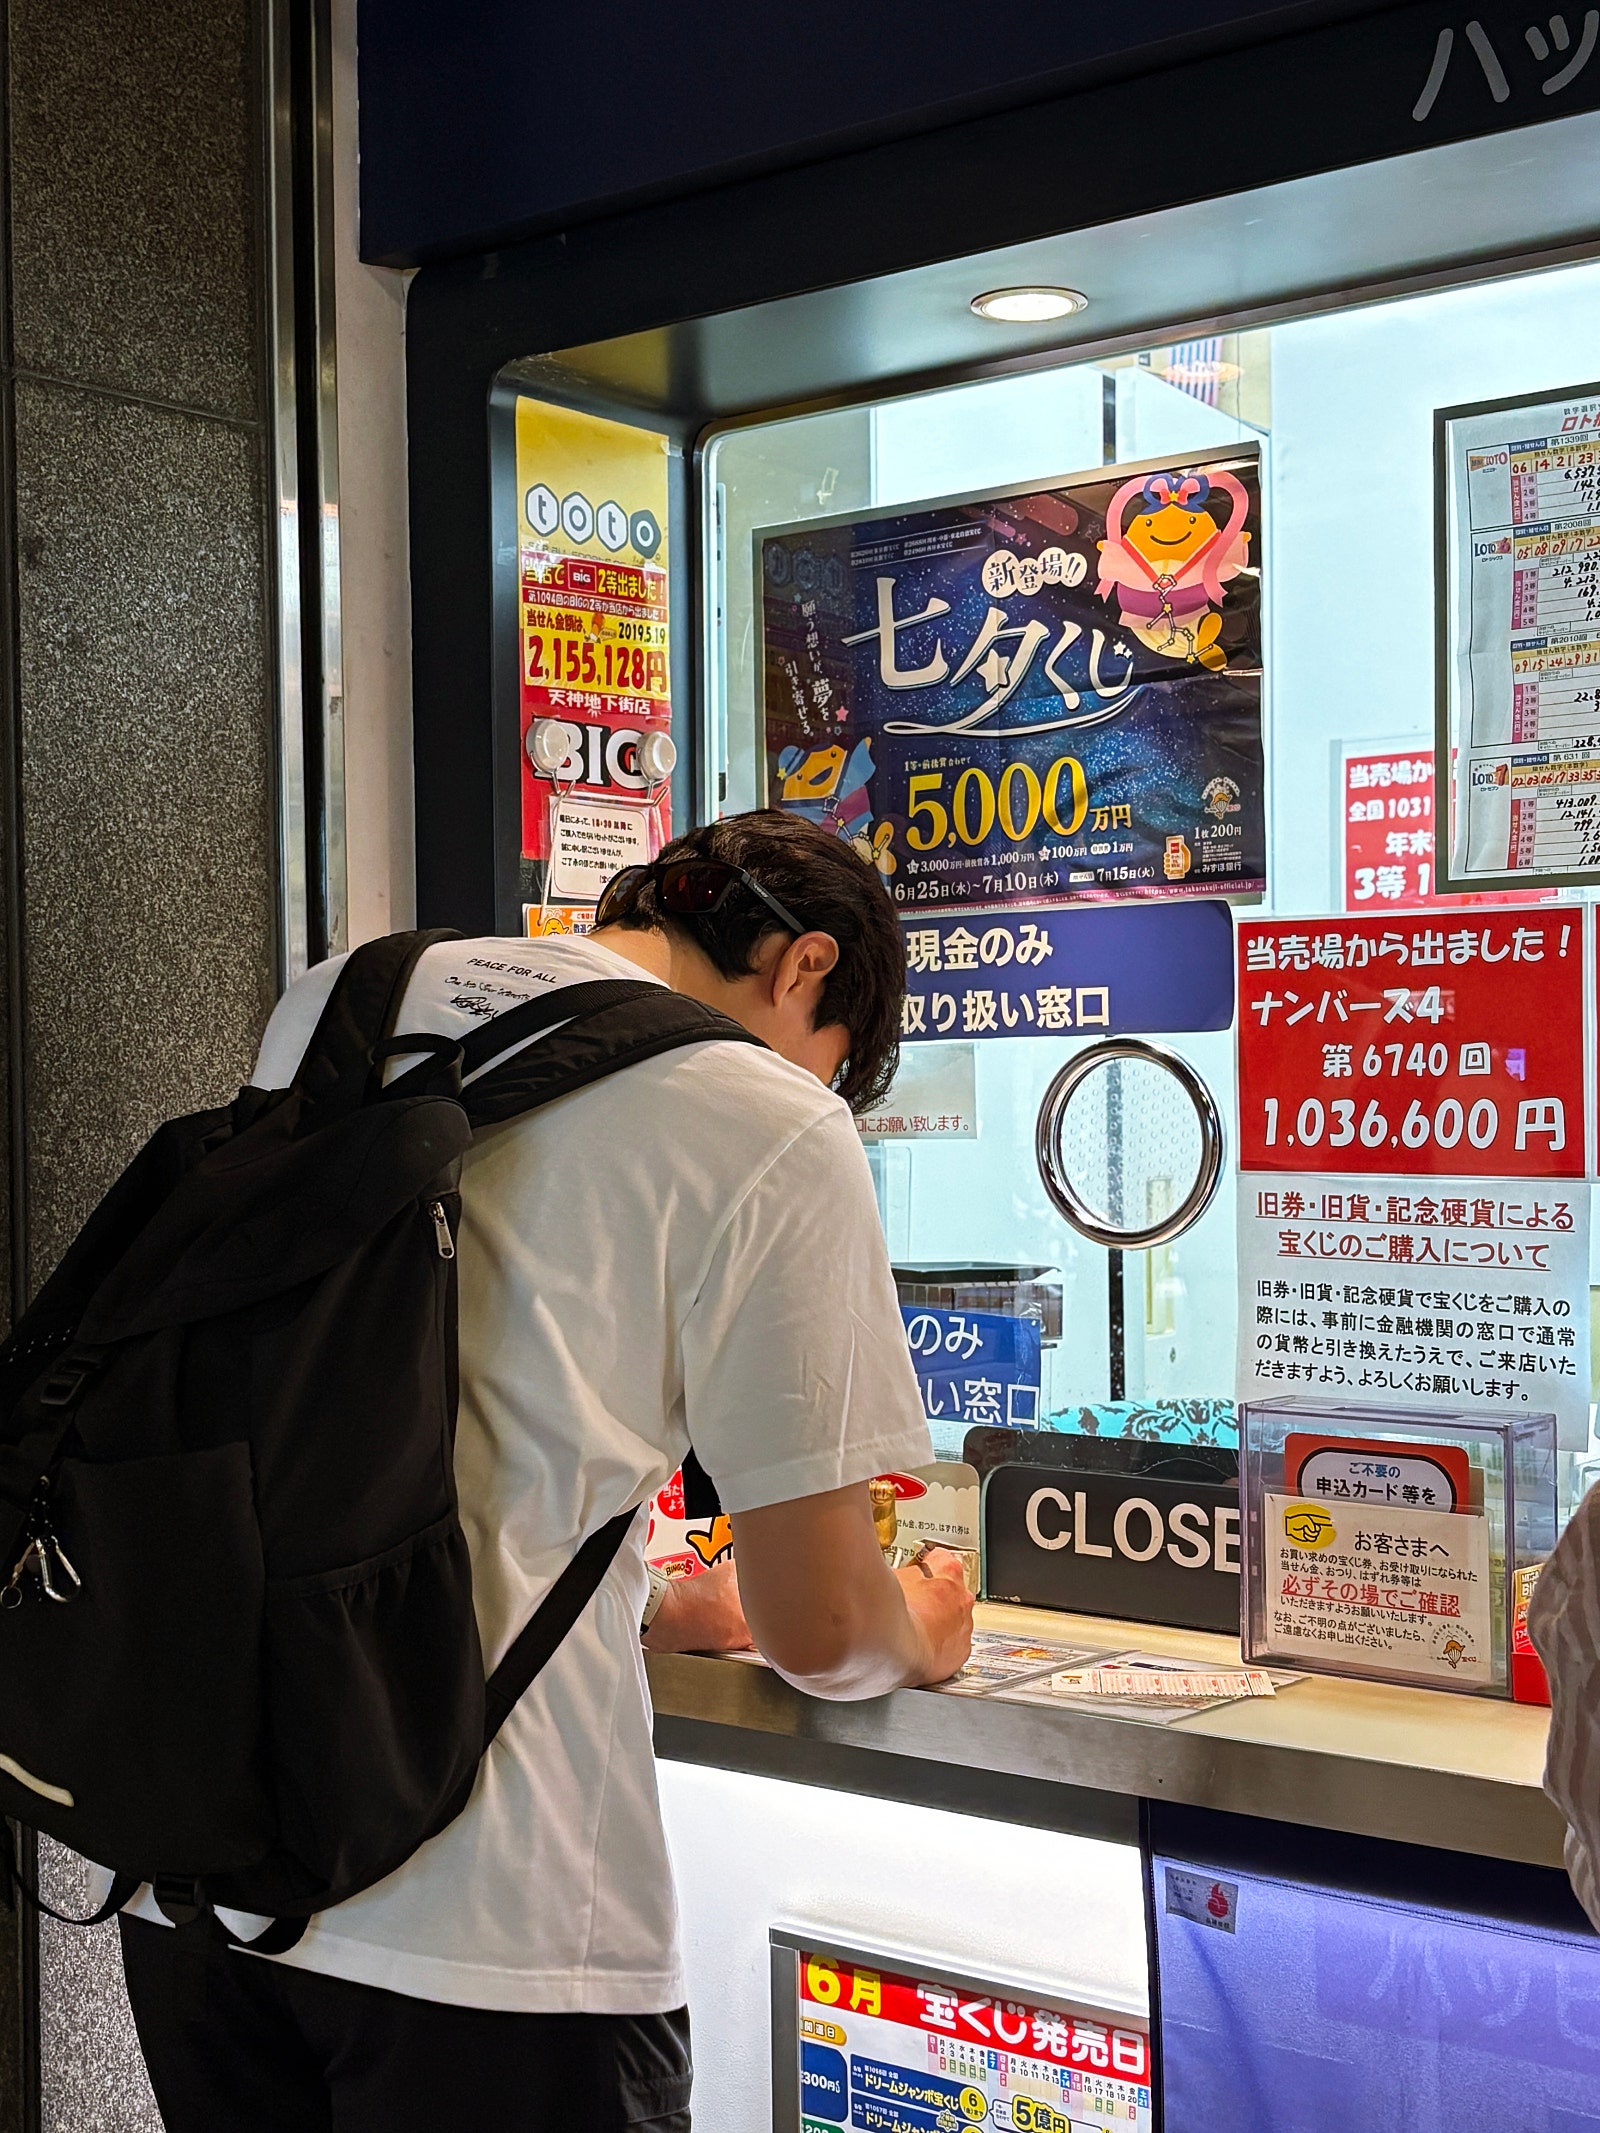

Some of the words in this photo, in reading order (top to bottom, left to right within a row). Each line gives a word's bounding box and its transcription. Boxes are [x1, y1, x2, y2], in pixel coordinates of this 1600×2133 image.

[1412, 9, 1600, 122] ハッ
[1512, 463, 1527, 474] 06
[1535, 459, 1550, 472] 14
[1556, 455, 1572, 467] 21
[1579, 453, 1593, 464] 23
[531, 489, 659, 553] toto
[1517, 547, 1532, 560] 05
[1535, 542, 1548, 556] 08
[1552, 539, 1565, 555] 09
[618, 622, 666, 645] 2019.5.19
[529, 635, 667, 693] 2,155,128円
[841, 577, 1134, 730] 七夕くじ
[1515, 660, 1528, 672] 09
[1533, 659, 1544, 671] 15
[548, 689, 651, 715] 天神地下街店
[1512, 777, 1525, 787] 02
[1527, 775, 1539, 785] 03
[1541, 773, 1552, 784] 06
[1568, 771, 1579, 782] 33
[1354, 865, 1407, 900] 3等
[906, 923, 1053, 973] 現金のみ
[1246, 924, 1571, 972] 当売場から出ました！
[467, 958, 507, 971] PEACE
[507, 965, 532, 977] FOR
[532, 972, 558, 984] ALL
[900, 985, 1110, 1034] 取り扱い窓口
[1251, 986, 1444, 1026] ナンバーズ4
[1362, 1042, 1448, 1077] 6740
[1263, 1098, 1499, 1148] 1,036,600
[1514, 1097, 1566, 1151] 円
[1256, 1191, 1574, 1230] 旧券・旧貨・記念硬貨による
[1278, 1229, 1551, 1268] 宝くじのご購入について
[1256, 1305, 1576, 1348] 際には、事前に金融機関の窓口で通常
[1257, 1334, 1576, 1376] の貨幣と引き換えたうえで、ご来店いた
[1255, 1359, 1530, 1402] だきますよう、よろしくお願いします。
[1349, 1462, 1400, 1479] ご不要の
[1354, 1531, 1449, 1558] お客さまへ
[1280, 1548, 1478, 1583] お買い求めの宝くじ券、お受け取りになられた
[1281, 1560, 1421, 1587] 当せん金、おつり、はずれ券等は
[1281, 1596, 1433, 1626] いただきますようお願いいたします。
[1282, 1574, 1460, 1616] 必ずその場でご確認
[1274, 1610, 1426, 1642] なお、ご不明の点がございましたら、
[1274, 1624, 1393, 1650] ご遠慮なくお申し出ください。
[916, 1982, 1146, 2076] 宝くじ発売日
[969, 2094, 977, 2107] 6
